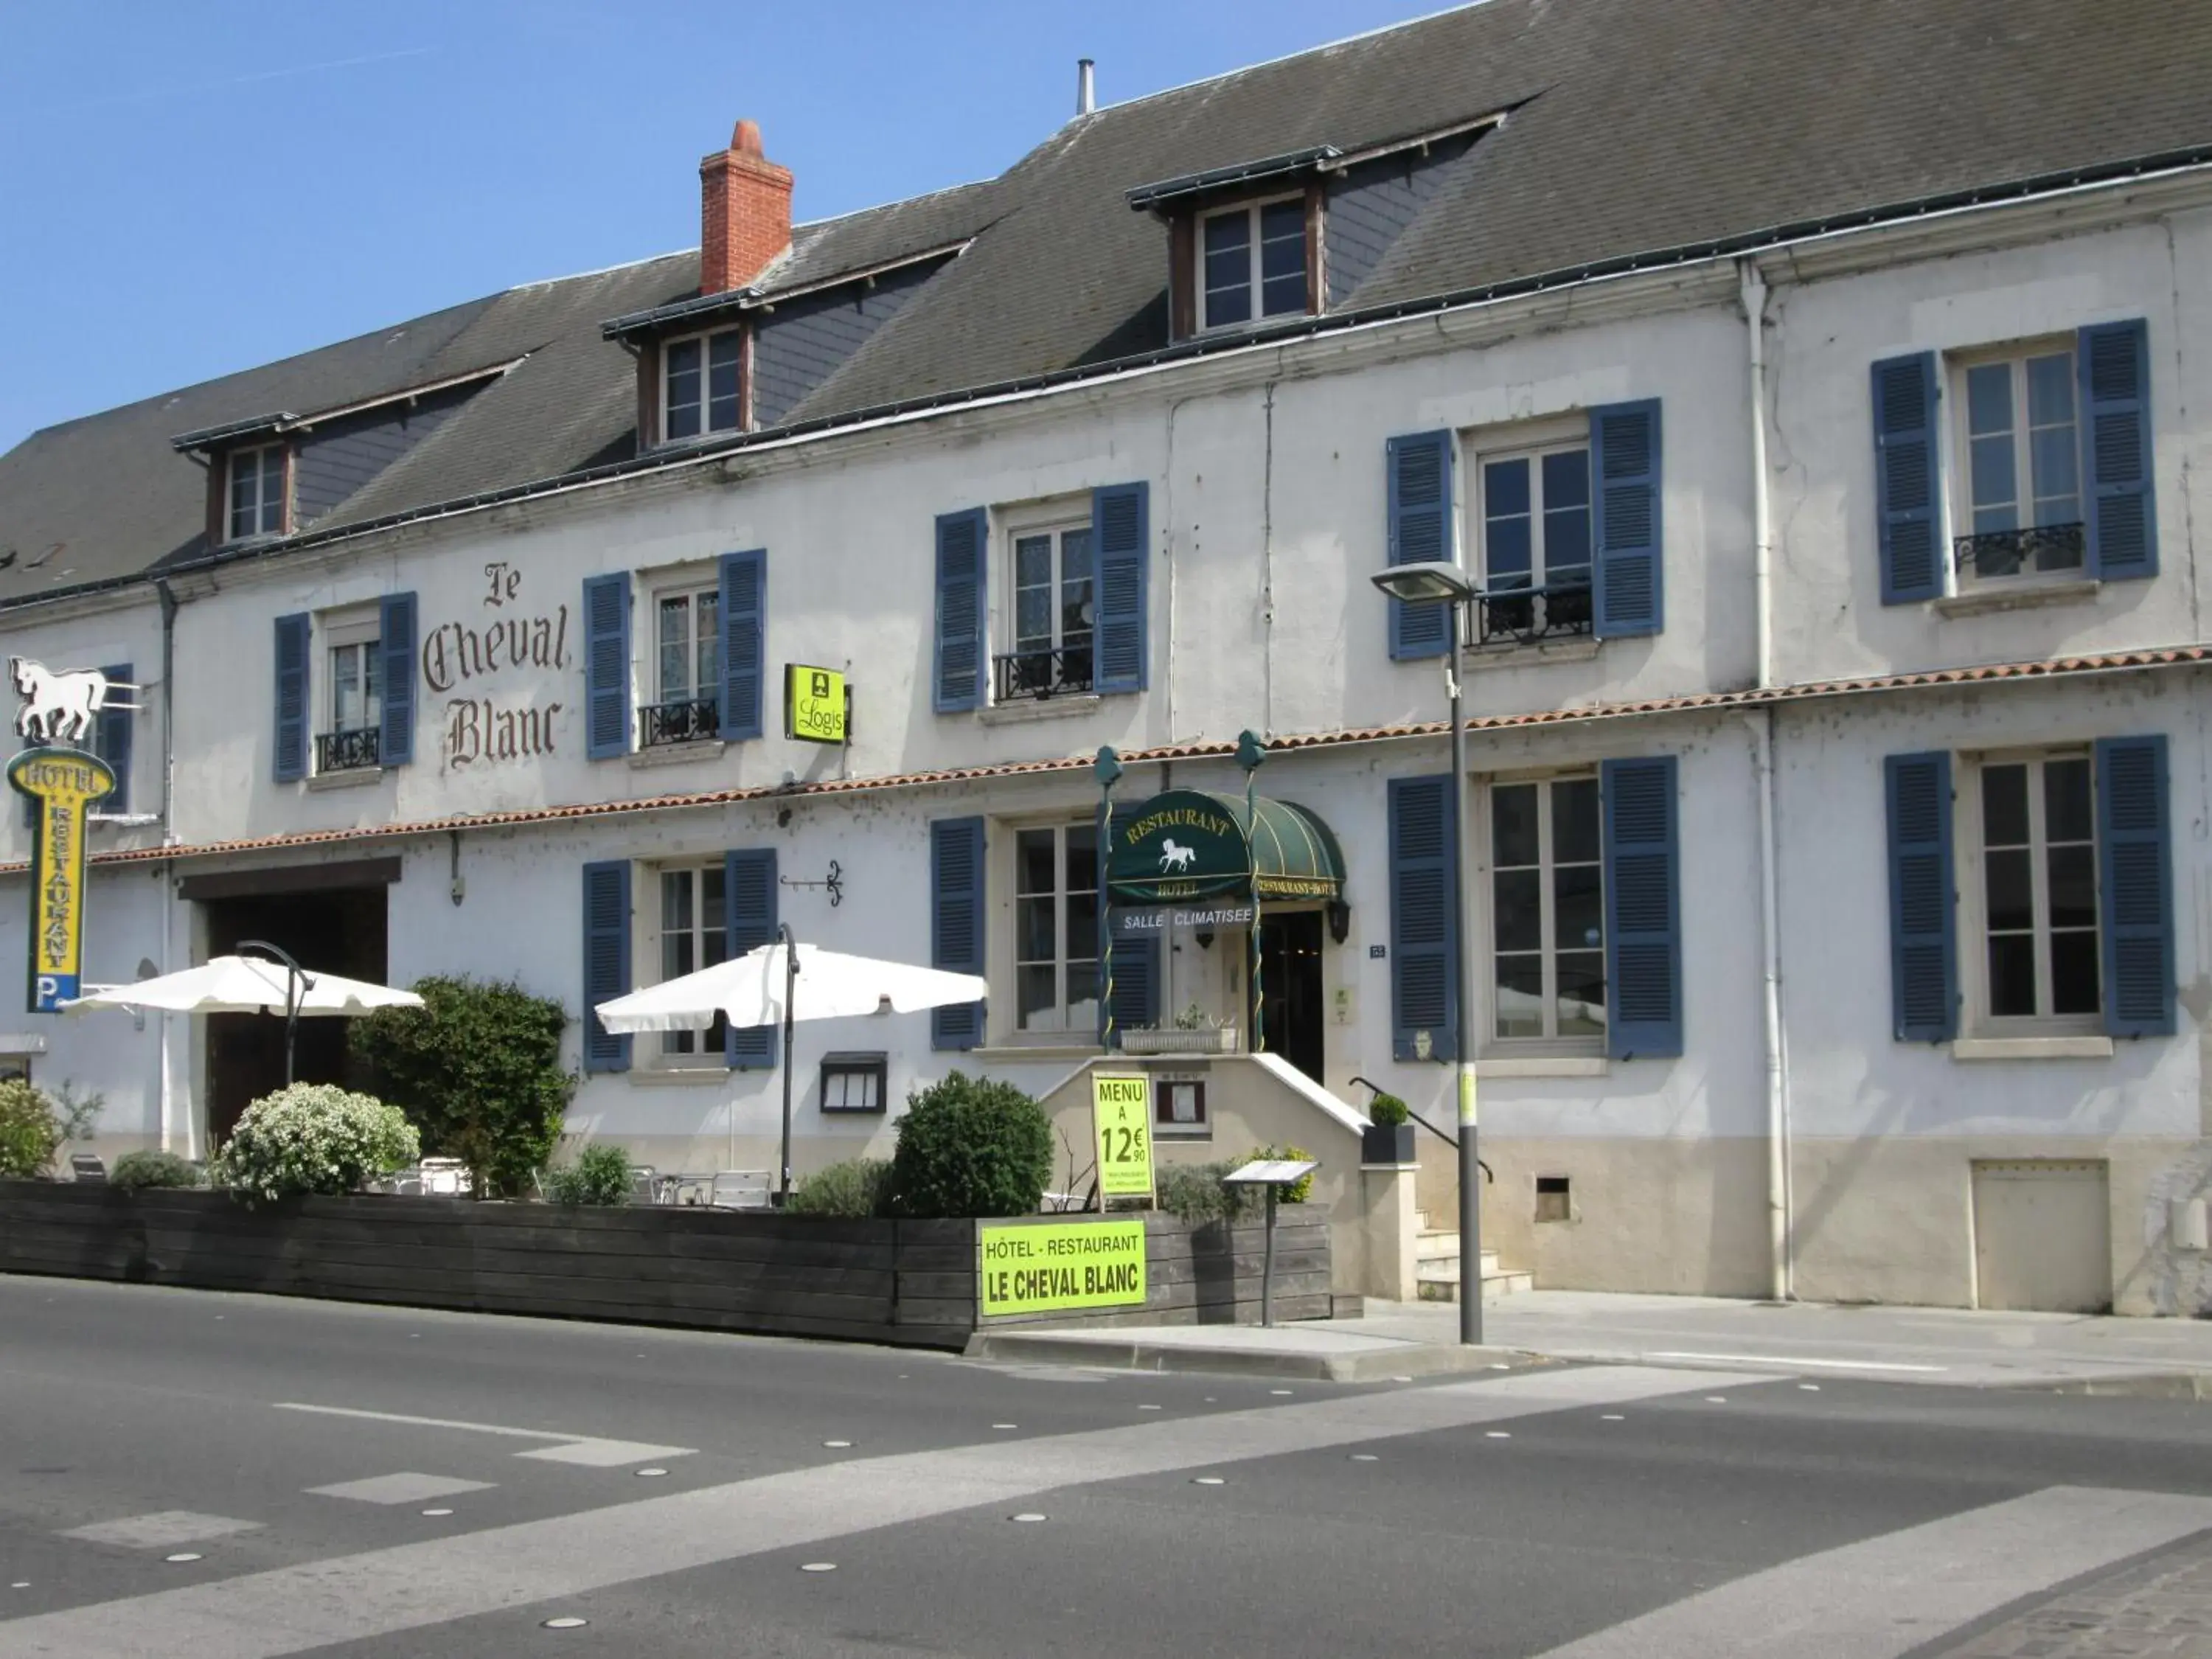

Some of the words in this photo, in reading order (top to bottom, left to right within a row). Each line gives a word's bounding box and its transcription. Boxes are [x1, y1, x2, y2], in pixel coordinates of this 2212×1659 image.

[484, 562, 521, 607] Le
[422, 604, 567, 692] Cheval
[447, 698, 563, 769] Blanc
[799, 698, 843, 735] Logis
[24, 762, 99, 793] HOTEL
[1126, 808, 1231, 845] RESTAURANT
[44, 805, 72, 969] RESTAURANT
[1156, 883, 1200, 897] HOTEL
[1124, 914, 1165, 930] SALLE
[1175, 908, 1252, 927] CLIMATISEE
[37, 977, 58, 1007] P
[1099, 1083, 1143, 1102] MENU
[986, 1237, 1034, 1259] HÔTEL
[1048, 1235, 1138, 1256] RESTAURANT
[989, 1270, 1009, 1303] LE
[1014, 1267, 1079, 1301] CHEVAL
[1085, 1262, 1138, 1295] BLANC
